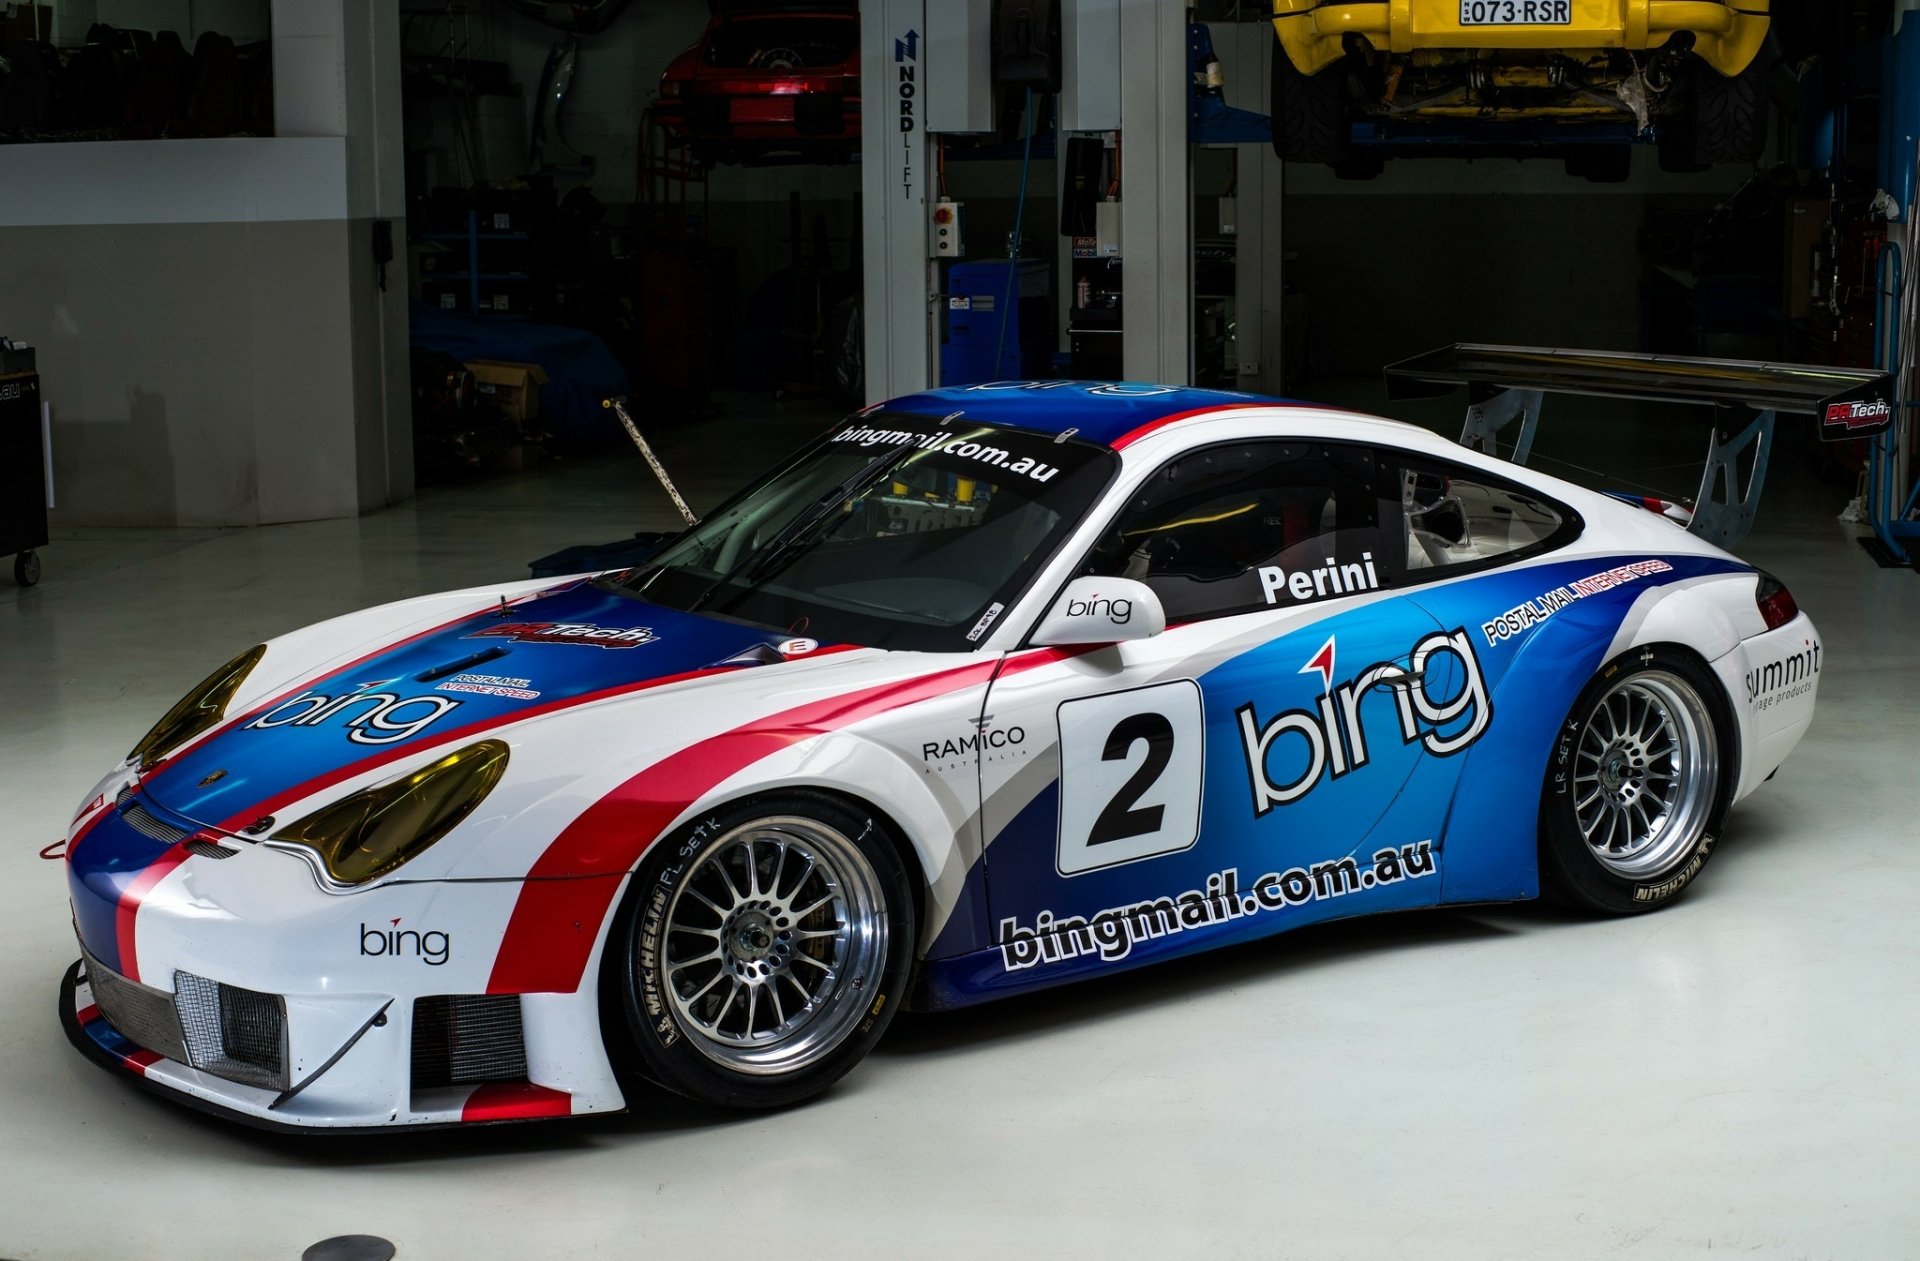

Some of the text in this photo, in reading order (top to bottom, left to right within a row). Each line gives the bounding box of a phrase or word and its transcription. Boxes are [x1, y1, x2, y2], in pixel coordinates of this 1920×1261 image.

[832, 425, 1059, 483] bingmail.com.au
[1066, 593, 1133, 625] bing
[1258, 552, 1379, 605] Perini
[1482, 602, 1547, 647] POSTAL
[1536, 586, 1581, 613] MAIL
[1745, 639, 1820, 704] summit
[1776, 682, 1812, 706] products
[240, 680, 466, 745] bing
[1236, 628, 1495, 819] bing
[1086, 711, 1176, 848] 2
[1000, 839, 1438, 972] bingmail.com.au
[1635, 855, 1703, 901] MICHELIN
[360, 918, 450, 966] bing
[640, 890, 667, 1016] MICHELIN
